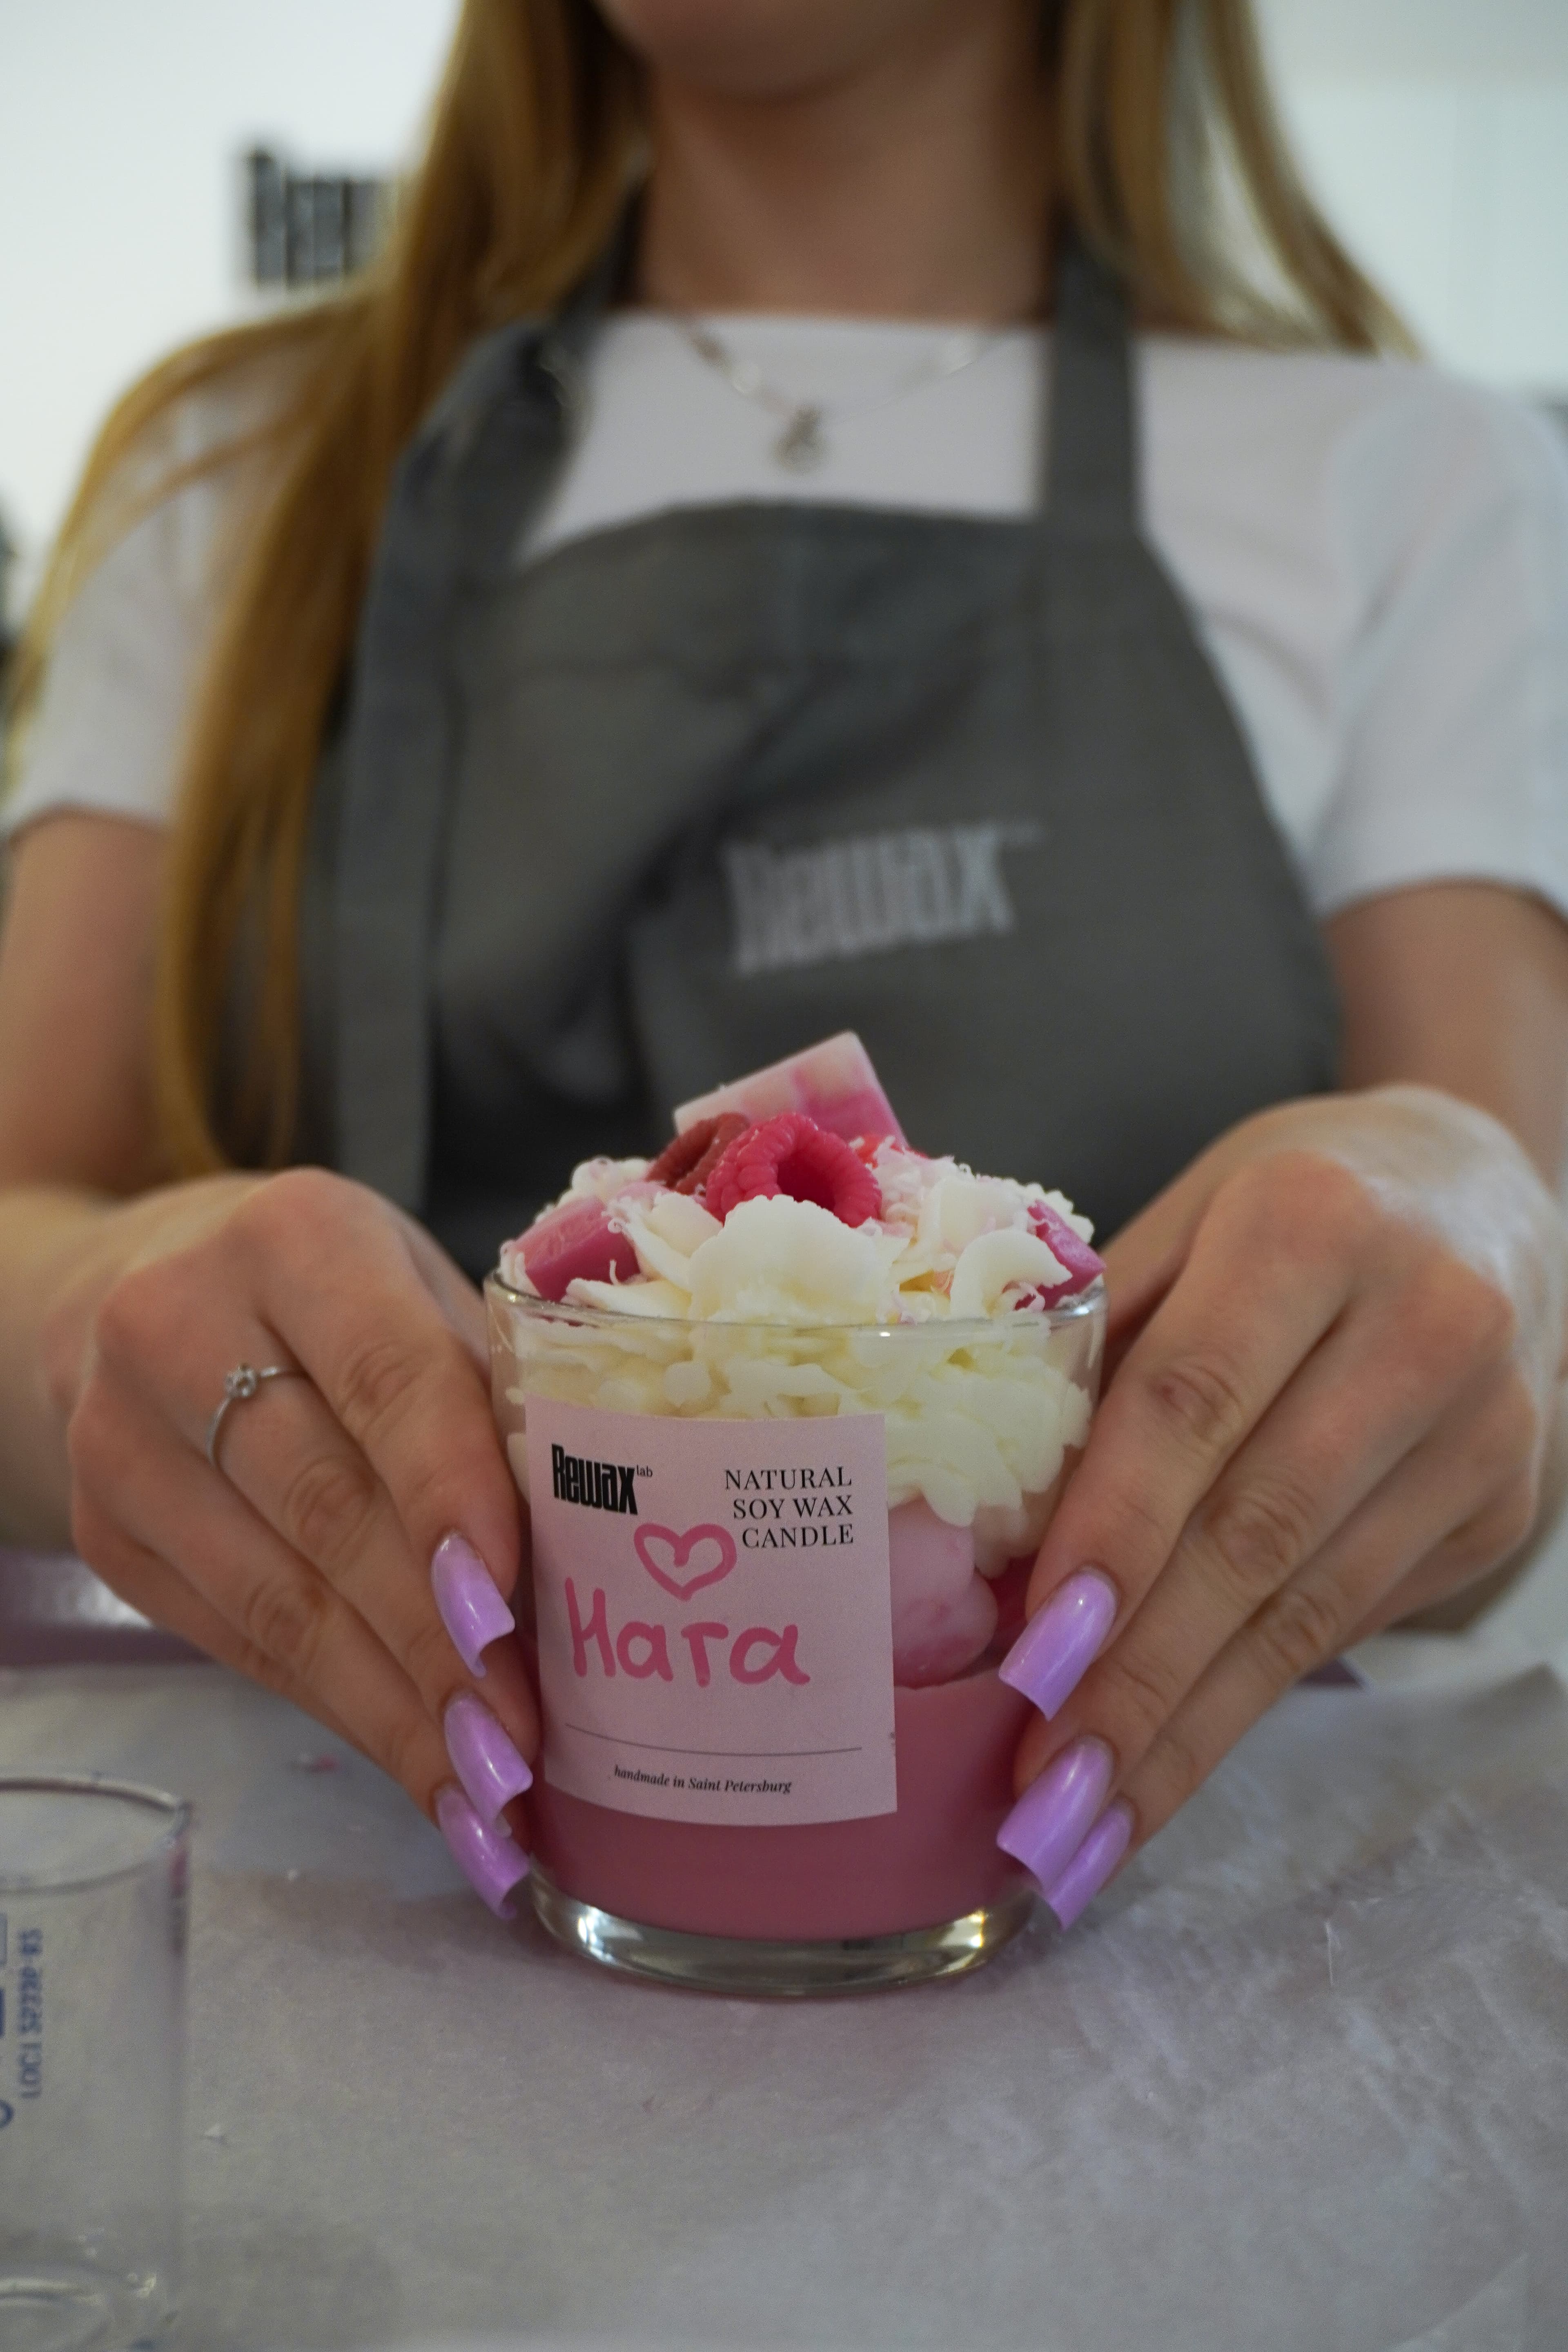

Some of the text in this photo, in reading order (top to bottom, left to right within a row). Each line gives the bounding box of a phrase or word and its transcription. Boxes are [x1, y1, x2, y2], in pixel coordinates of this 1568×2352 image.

[551, 1443, 653, 1515] Rewax lab
[725, 1466, 852, 1490] NATURAL
[733, 1494, 853, 1519] SOY WAX
[742, 1523, 854, 1549] CANDLE
[614, 1764, 792, 1795] handmade in Saint Petersburg
